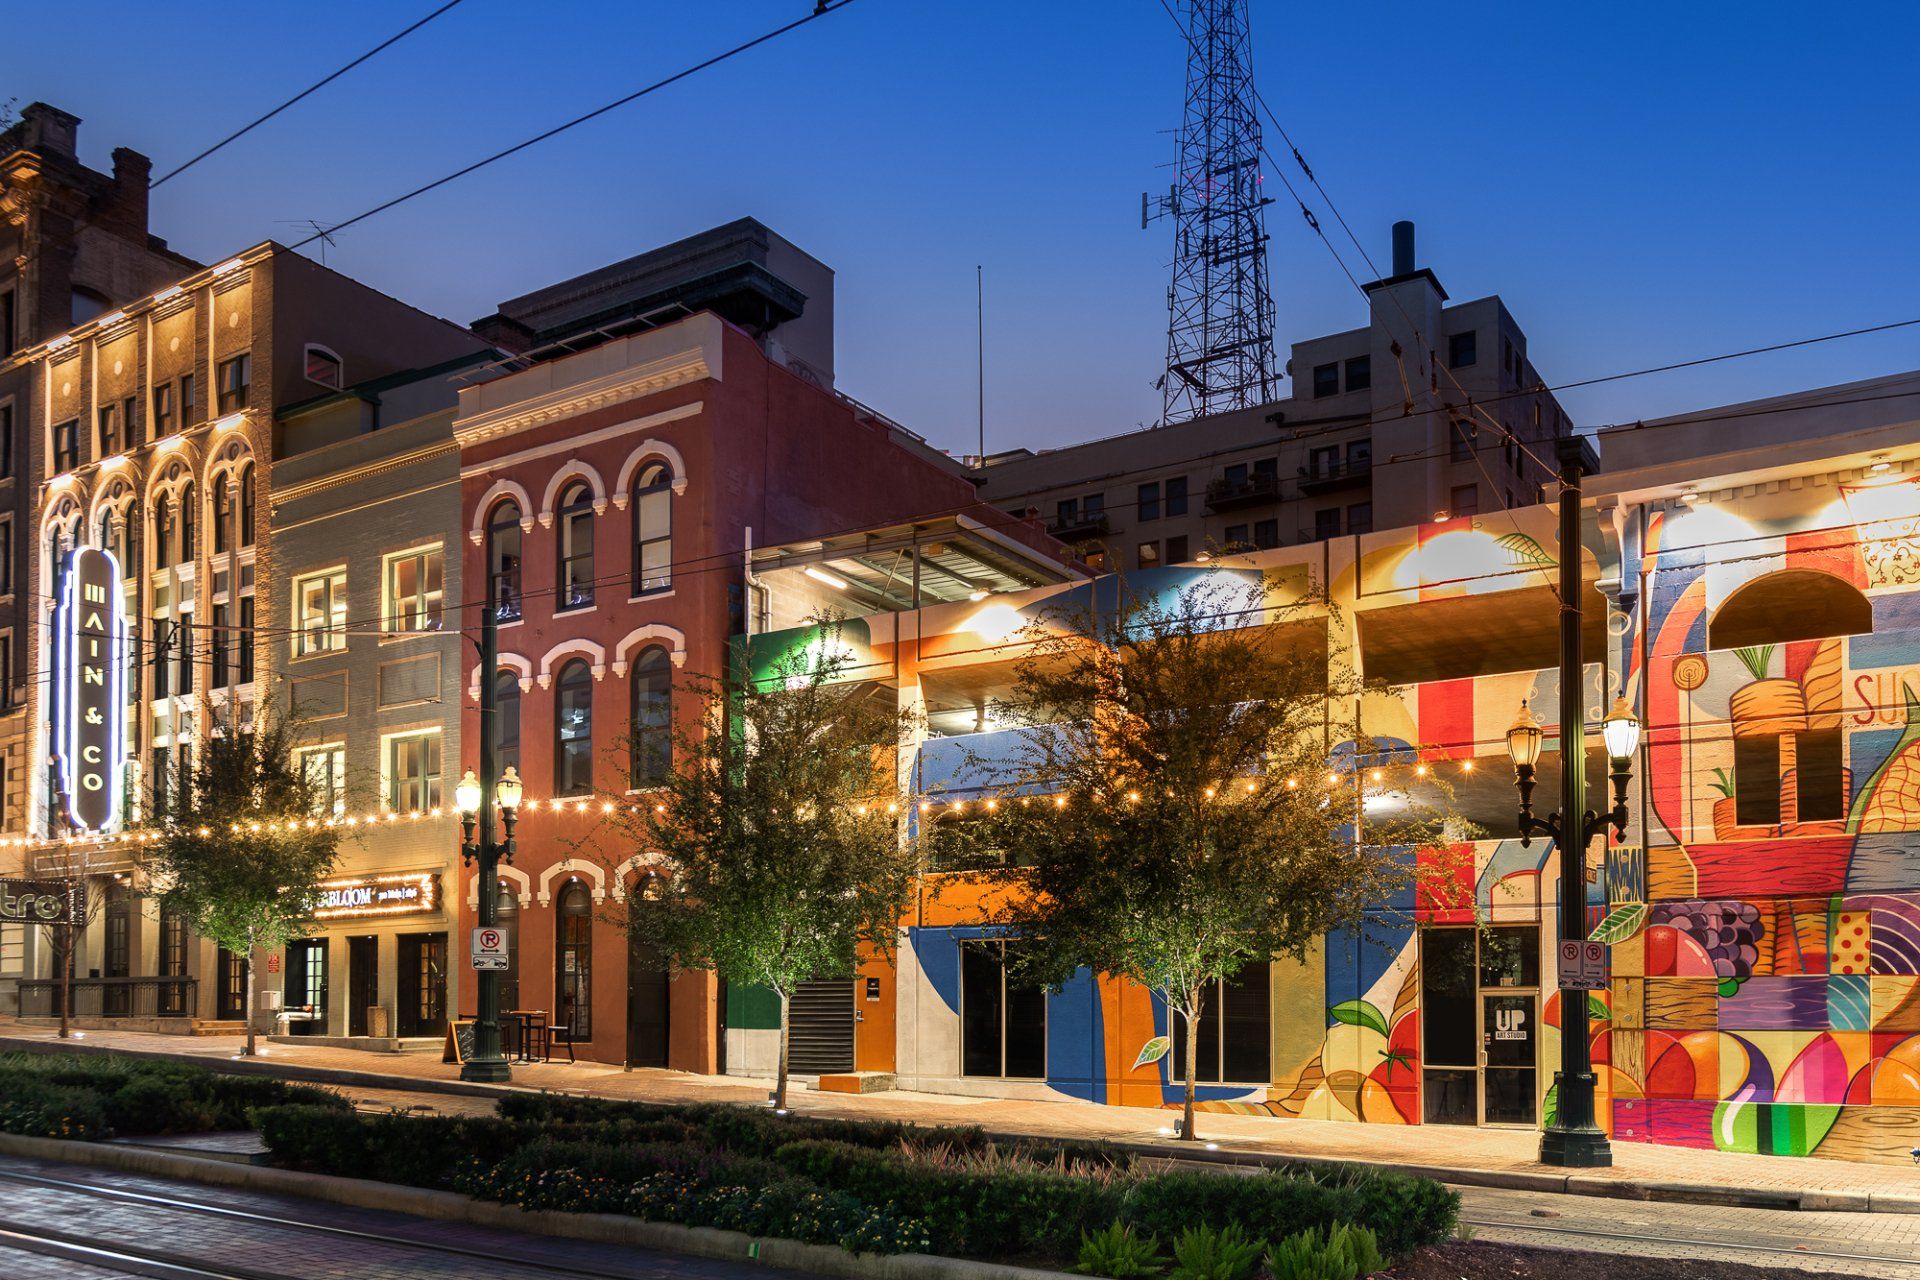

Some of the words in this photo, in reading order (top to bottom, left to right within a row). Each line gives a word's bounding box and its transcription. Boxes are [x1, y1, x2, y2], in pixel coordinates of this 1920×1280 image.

[85, 706, 103, 725] &
[82, 745, 104, 791] CO
[0, 882, 62, 919] tro
[1496, 1010, 1525, 1031] UP
